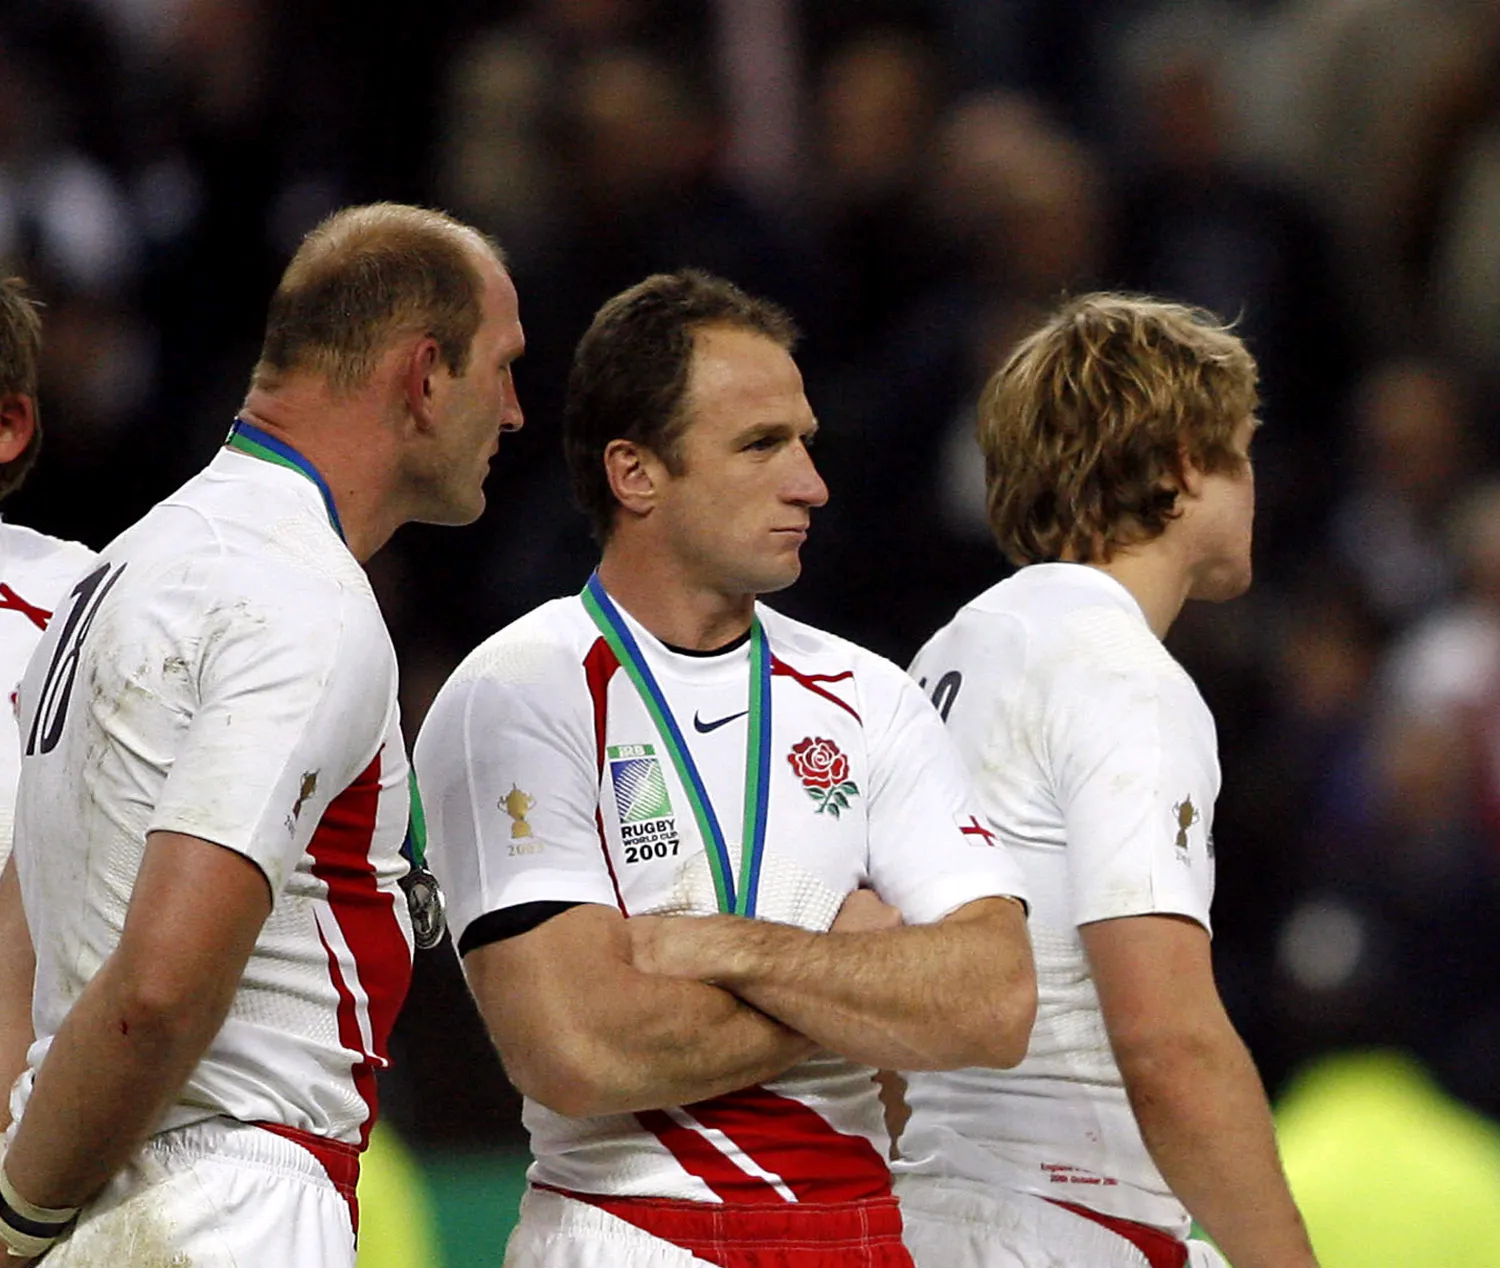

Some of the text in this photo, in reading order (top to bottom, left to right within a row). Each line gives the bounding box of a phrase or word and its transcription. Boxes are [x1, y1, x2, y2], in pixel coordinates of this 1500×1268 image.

[26, 561, 128, 756] 18
[621, 819, 675, 839] RUGBY
[623, 831, 678, 847] WORLD CUP
[625, 840, 680, 864] 2007
